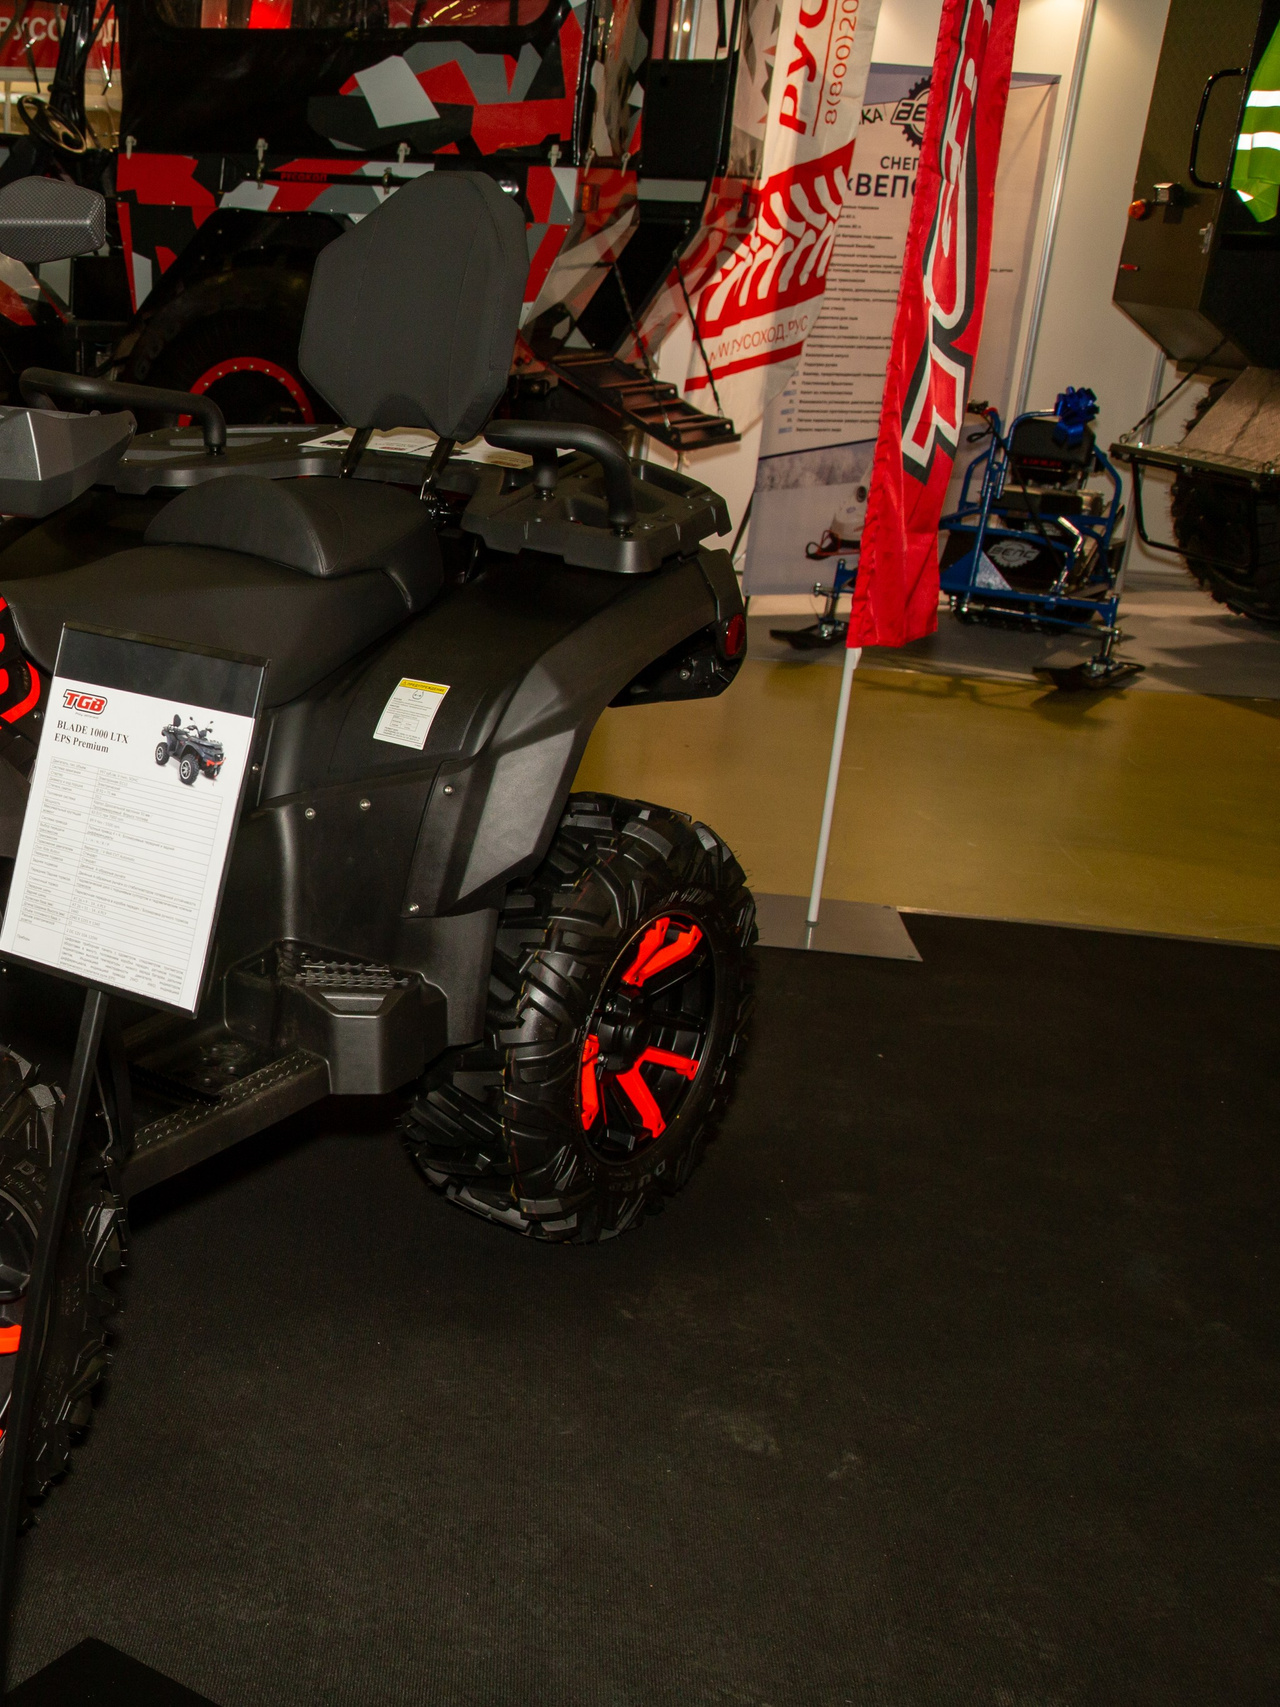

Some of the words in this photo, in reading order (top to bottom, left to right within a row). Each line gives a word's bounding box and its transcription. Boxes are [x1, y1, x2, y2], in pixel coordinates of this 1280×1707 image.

[859, 108, 883, 125] КА
[880, 156, 919, 170] СНЕГ
[847, 173, 916, 198] «ВЕП
[63, 689, 107, 714] TGB
[54, 732, 71, 744] EPS
[73, 738, 109, 753] Premium
[57, 719, 88, 735] BLADE
[90, 727, 109, 739] 1000
[110, 731, 129, 744] LTX
